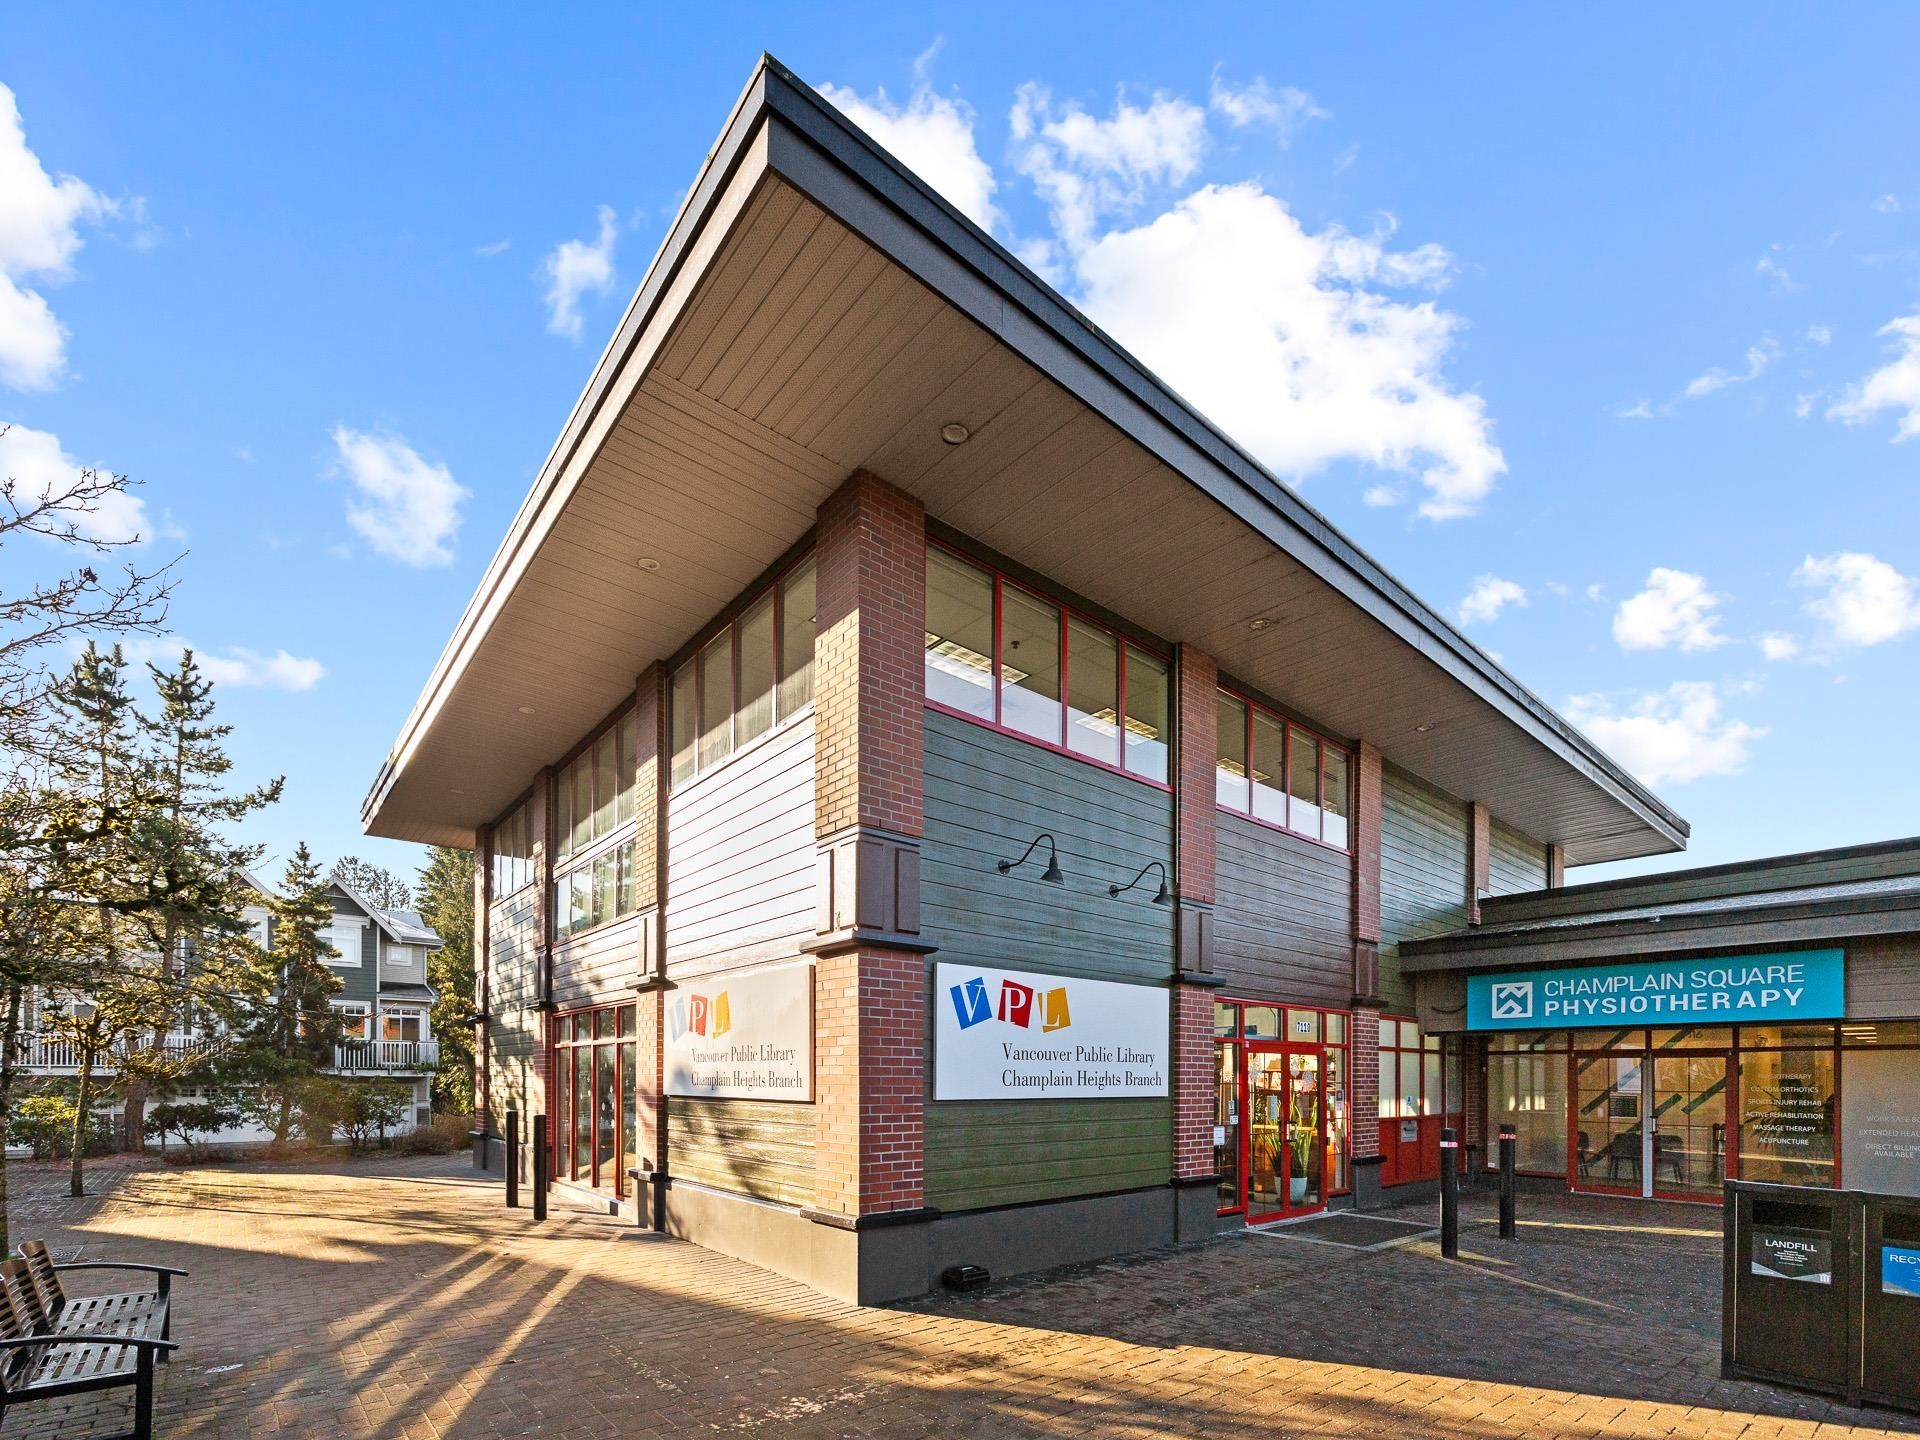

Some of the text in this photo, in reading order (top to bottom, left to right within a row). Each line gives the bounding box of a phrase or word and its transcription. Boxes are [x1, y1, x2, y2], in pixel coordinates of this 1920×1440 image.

[1544, 964, 1805, 996] CHAMPLAIN SQUARE
[954, 980, 1065, 1029] VPL
[1544, 987, 1805, 1017] PHYSIOTHERAPY
[1296, 1021, 1311, 1033] 7110
[691, 1044, 796, 1066] Vancouver Public Library
[1002, 1043, 1156, 1068] Vancouver Public Library
[691, 1070, 802, 1091] Champlain Heights Branch
[1002, 1069, 1162, 1091] Champlain Heights Branch
[1759, 1137, 1809, 1145] ACUPUNCTURE
[1874, 1150, 1914, 1158] AVAILABLE
[1765, 1239, 1818, 1253] LANDFILL
